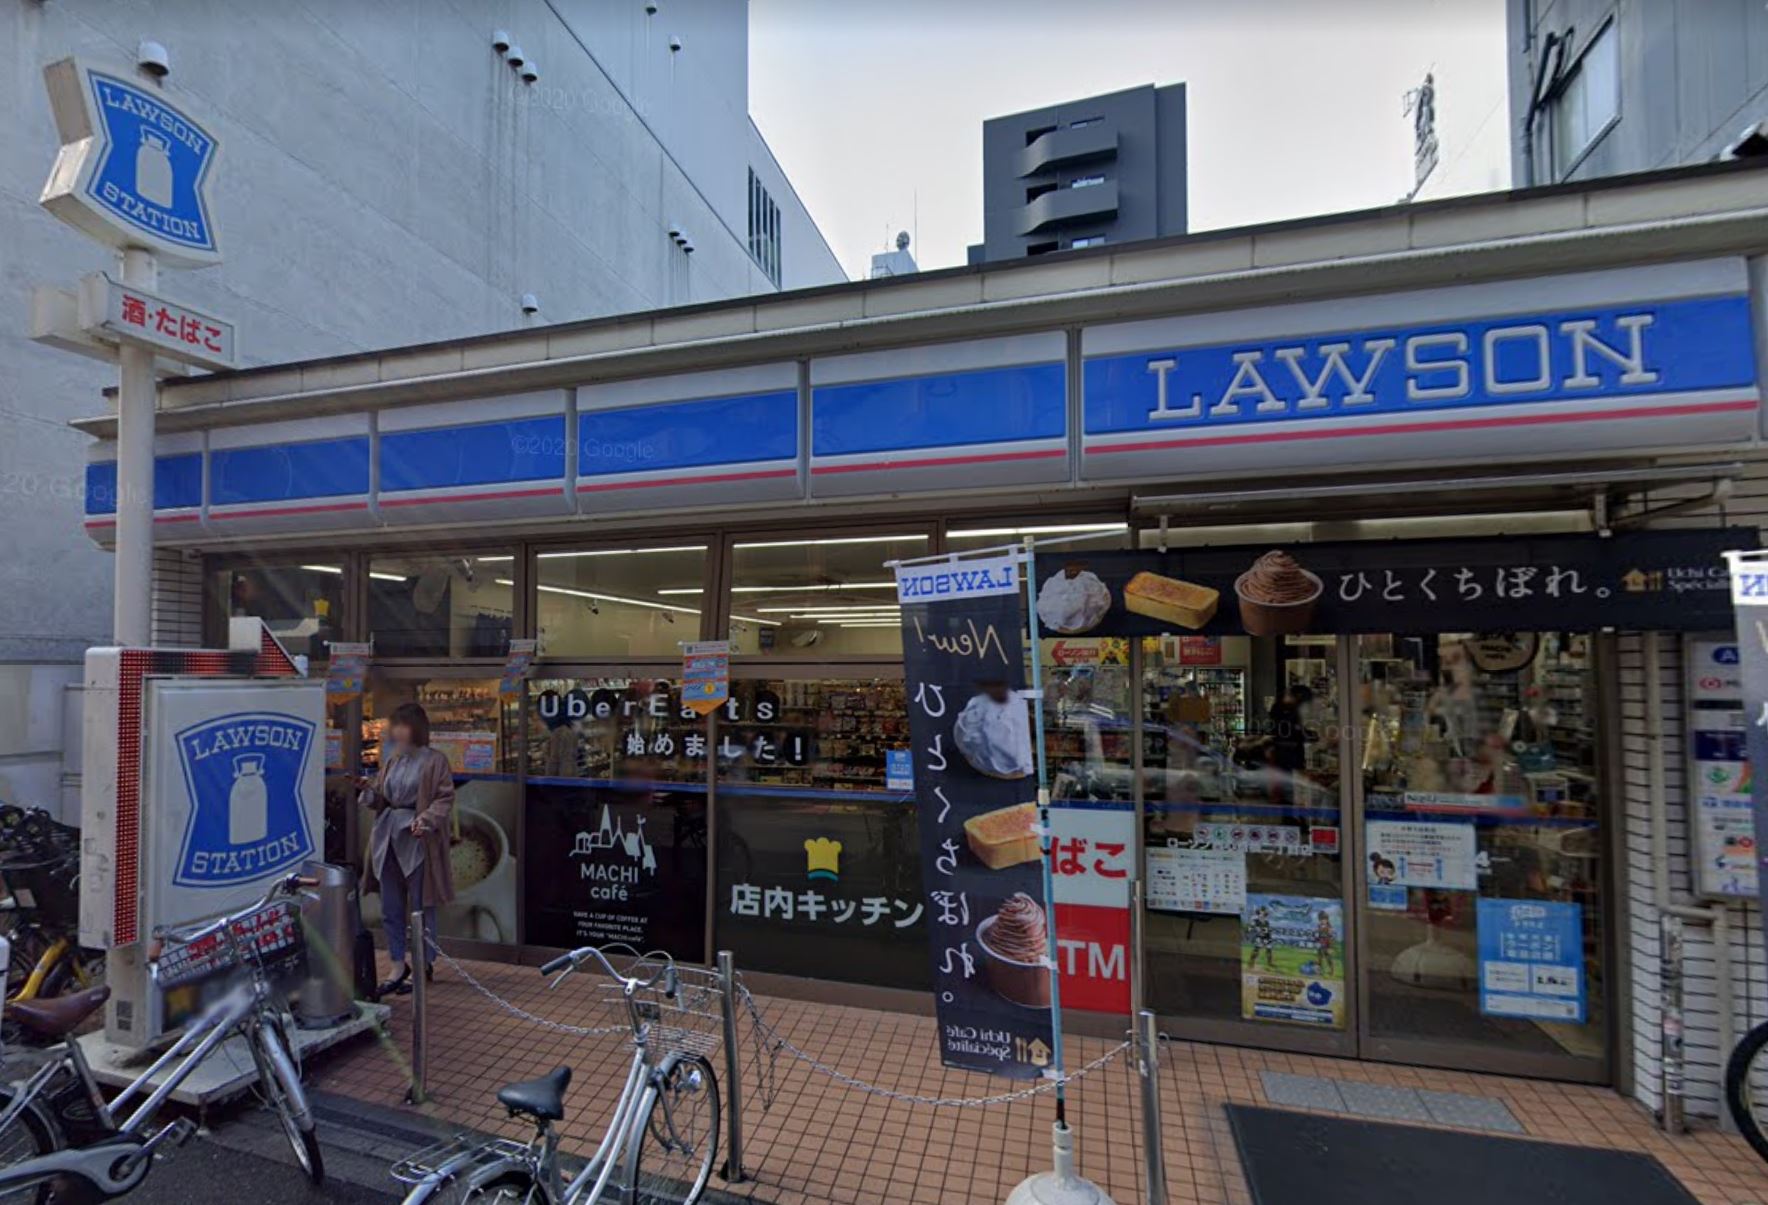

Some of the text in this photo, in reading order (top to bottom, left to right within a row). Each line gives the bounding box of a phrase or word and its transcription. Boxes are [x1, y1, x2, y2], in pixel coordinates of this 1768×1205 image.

[103, 87, 204, 155] LAWSON
[103, 181, 200, 239] STATION
[1147, 313, 1658, 421] LAWSON
[1339, 565, 1611, 601] ひとくちぼれ。
[191, 725, 304, 760] LAWSON
[191, 831, 300, 874] STATION
[580, 863, 639, 883] MACHI
[1050, 835, 1128, 879] ばこ
[590, 884, 629, 901] café
[729, 883, 924, 928] 店内キッチン
[1055, 938, 1126, 981] TM
